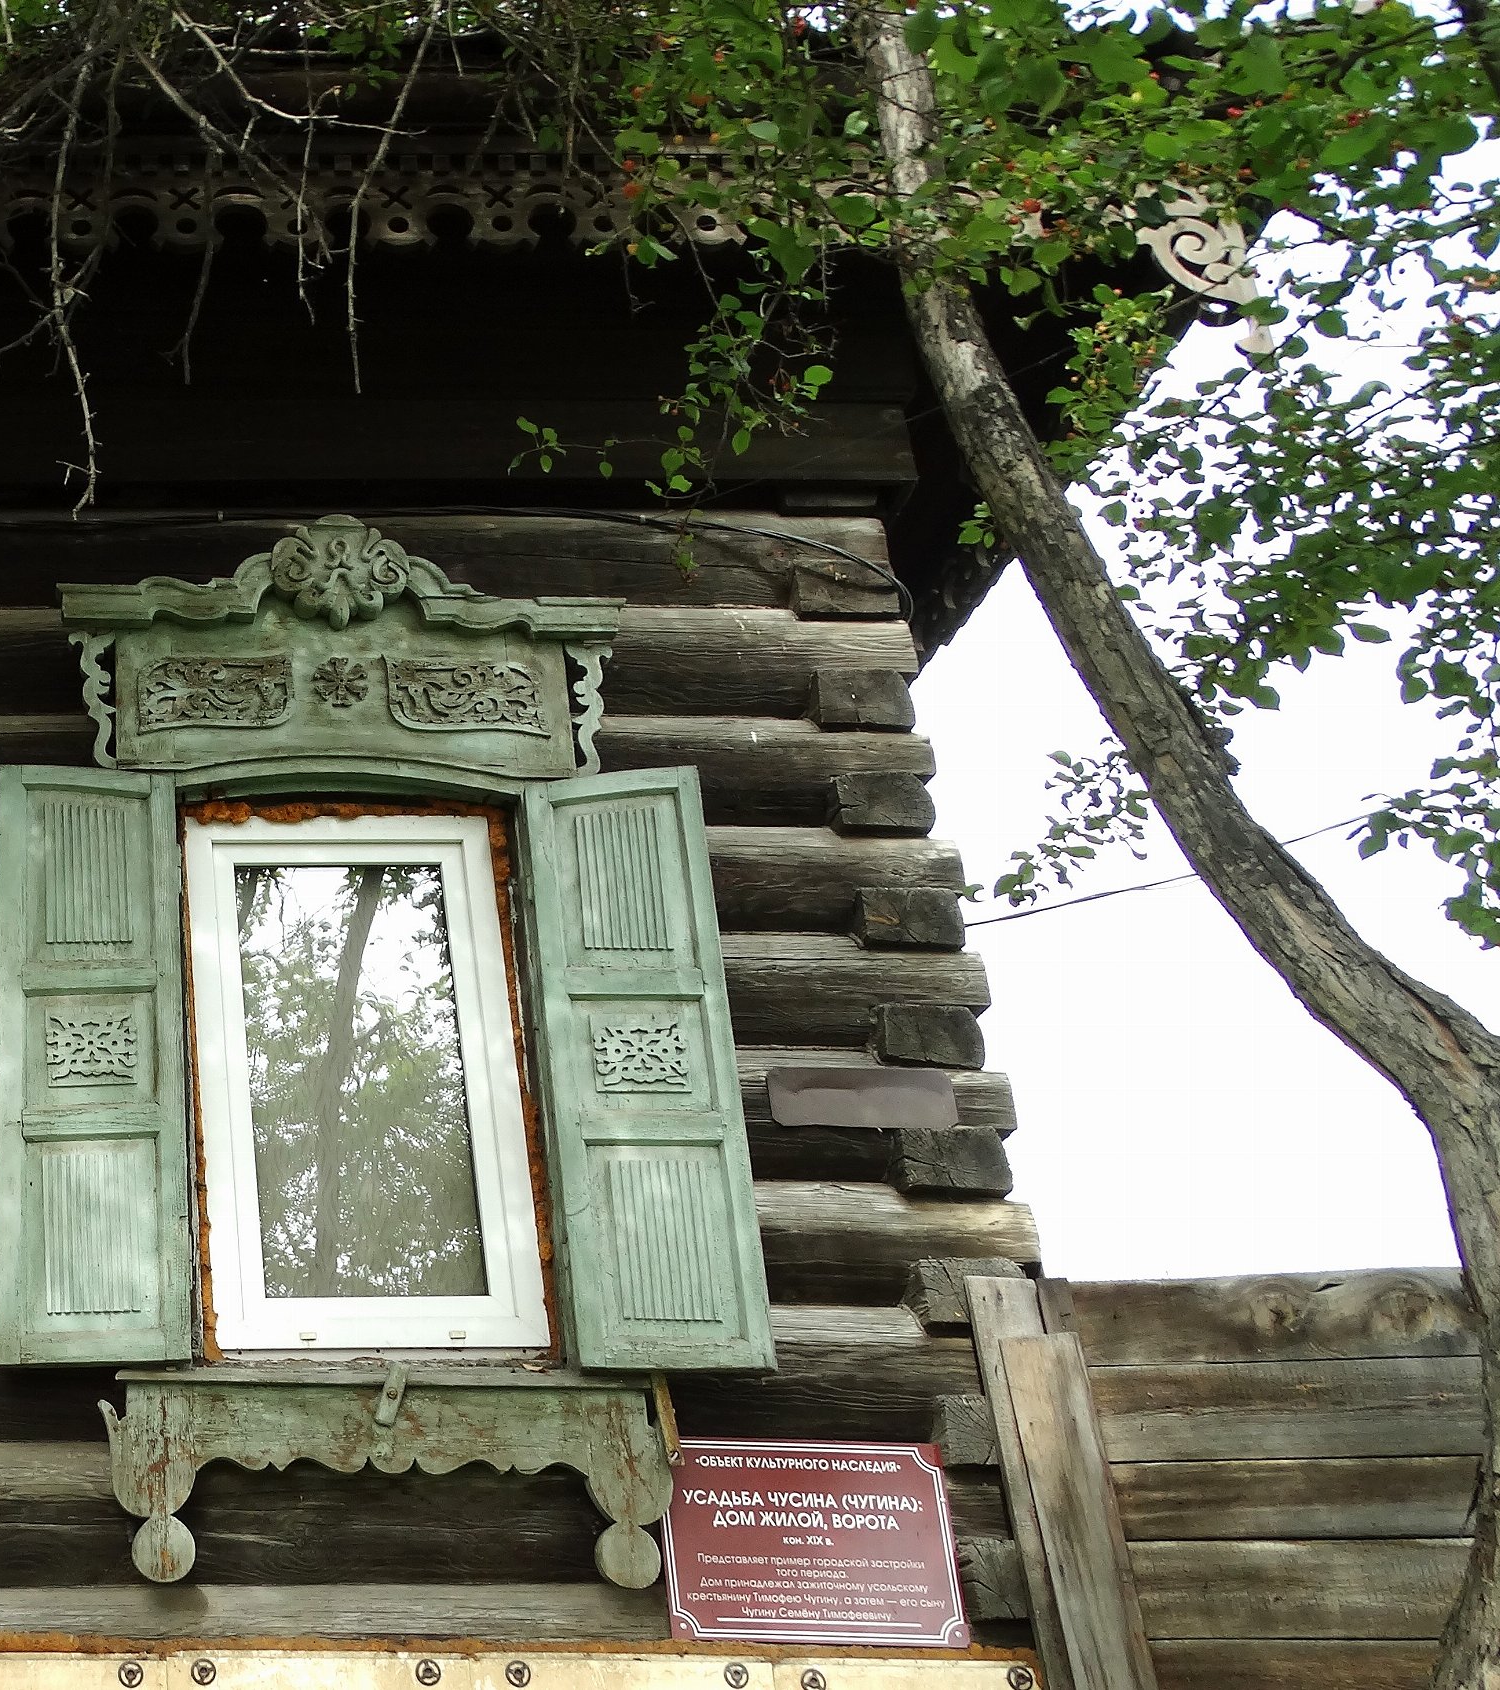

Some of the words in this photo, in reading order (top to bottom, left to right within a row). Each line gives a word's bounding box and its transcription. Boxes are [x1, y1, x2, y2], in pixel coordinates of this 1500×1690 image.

[746, 1457, 829, 1471] КУЛЬТУРНОГО
[682, 1489, 764, 1508] УСАДЬБА
[767, 1492, 838, 1509] ЧУСИНА
[842, 1494, 923, 1512] (ЧУГИНА):
[713, 1510, 755, 1528] ДОМ
[759, 1511, 828, 1530] ЖИЛОЙ,
[832, 1513, 900, 1530] ВОРОТА
[783, 1537, 804, 1545] кон.
[806, 1536, 824, 1545] XIX
[826, 1538, 834, 1546] в.
[697, 1553, 768, 1564] Представляет
[771, 1557, 810, 1567] пример
[813, 1558, 869, 1568] городской
[871, 1560, 925, 1570] застройки
[776, 1568, 798, 1576] того
[800, 1570, 849, 1579] периода.
[700, 1577, 722, 1588] Дом
[725, 1579, 795, 1589] принадлежал
[797, 1581, 864, 1592] зажиточному
[867, 1584, 928, 1594] усольскому
[687, 1592, 751, 1603] крестьянину
[753, 1592, 801, 1604] Тимофею
[854, 1597, 884, 1605] затем
[899, 1599, 917, 1607] его
[920, 1599, 946, 1609] сыну
[741, 1607, 776, 1618] Чугину
[779, 1608, 820, 1619] Семёну
